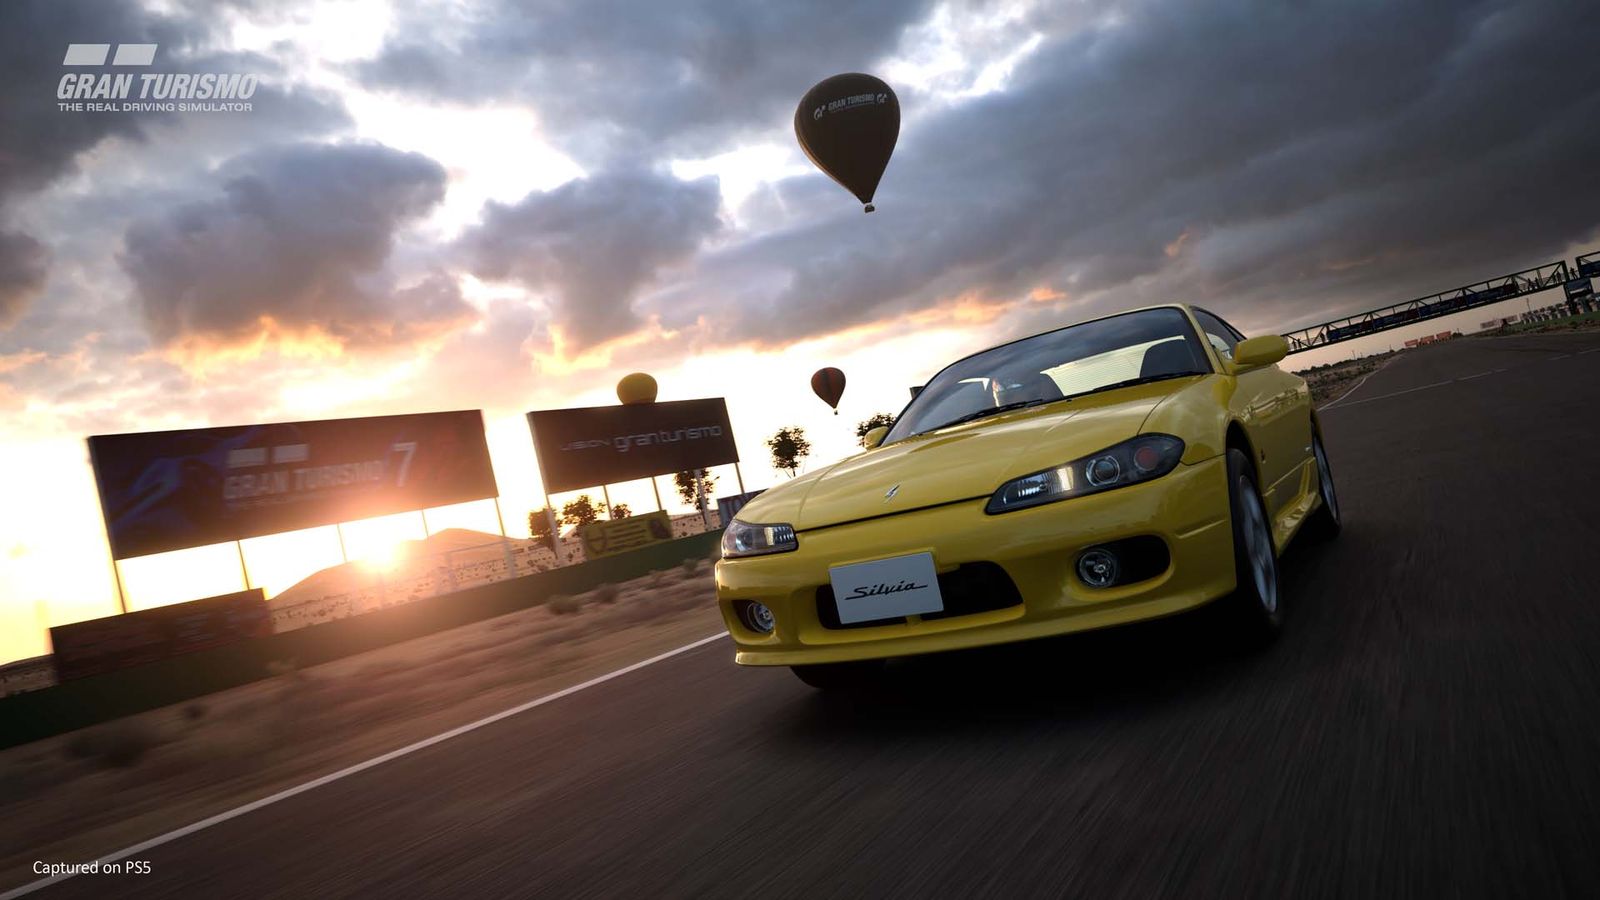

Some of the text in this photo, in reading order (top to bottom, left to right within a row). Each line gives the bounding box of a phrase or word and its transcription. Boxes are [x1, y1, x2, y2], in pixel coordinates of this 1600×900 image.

[828, 98, 846, 111] GRAN
[847, 93, 875, 105] TURISMO
[224, 470, 289, 499] GRAN
[294, 460, 382, 490] TURISMO
[392, 441, 418, 487] 7
[845, 580, 928, 600] Silvia
